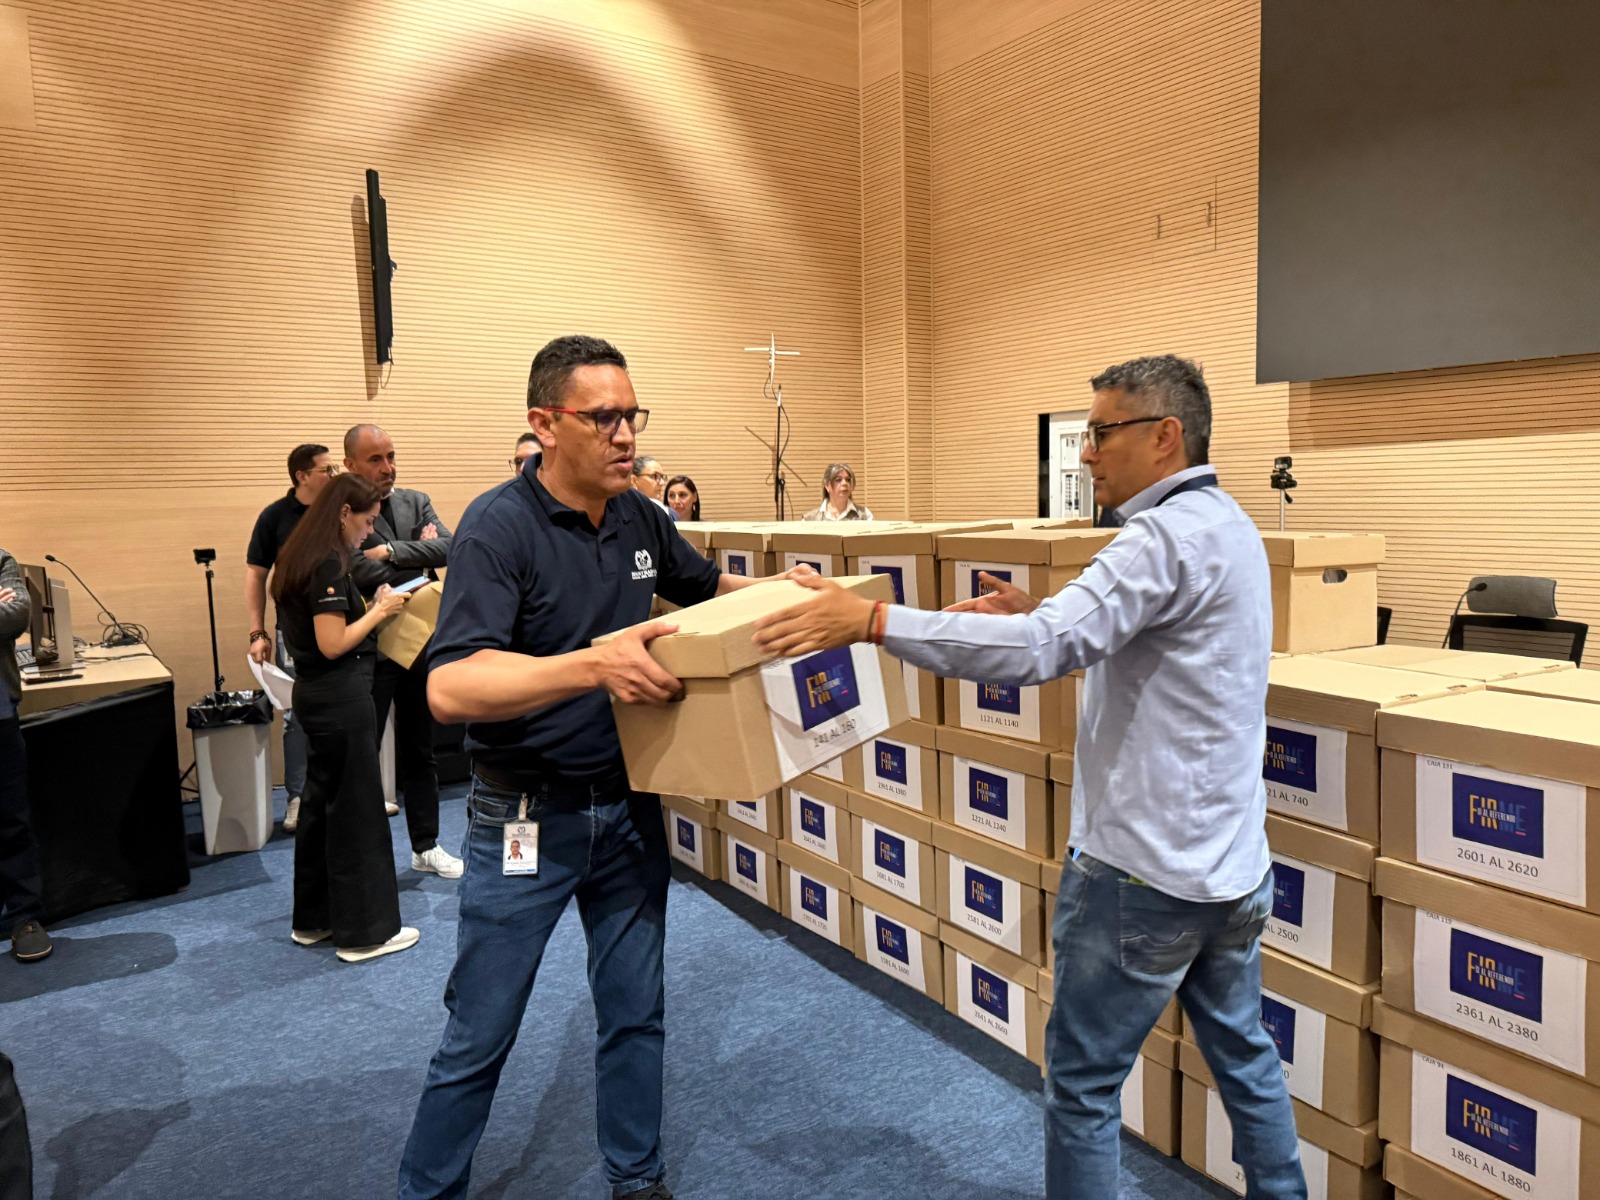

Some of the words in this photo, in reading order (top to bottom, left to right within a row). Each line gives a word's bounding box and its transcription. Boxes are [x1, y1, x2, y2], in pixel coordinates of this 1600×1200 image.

[979, 714, 994, 724] 1121
[994, 716, 1003, 725] AL
[1003, 718, 1019, 728] 1140
[1426, 759, 1441, 768] CAJA
[889, 785, 896, 794] AL
[1266, 787, 1278, 799] 21
[1279, 791, 1291, 802] AL
[1292, 795, 1308, 807] 740
[1469, 794, 1527, 832] FIRME
[1483, 808, 1489, 818] AL
[1489, 809, 1516, 823] REFERENDO
[971, 813, 986, 826] 1221
[985, 818, 993, 829] AL
[993, 821, 1007, 833] 1240
[1457, 847, 1485, 864] 2601
[1489, 856, 1504, 869] AL
[1507, 860, 1539, 878] 2620
[888, 876, 895, 886] AL
[893, 878, 906, 890] 1700
[967, 912, 980, 926] 2581
[980, 919, 988, 931] AL
[988, 923, 1002, 937] 2600
[1426, 911, 1441, 922] CAJA
[1264, 923, 1275, 935] AL
[1277, 927, 1299, 943] 2500
[892, 960, 899, 970] AL
[1467, 951, 1525, 996] FIRME
[1481, 966, 1487, 976] AL
[1487, 968, 1514, 986] REFERENDO
[987, 1016, 995, 1028] AL
[1456, 1002, 1485, 1022] 2361
[1488, 1015, 1503, 1030] AL
[1507, 1021, 1538, 1042] 2380
[1422, 1055, 1436, 1065] CAJA
[1476, 1114, 1482, 1123] AL
[1451, 1147, 1478, 1169] 1861
[1482, 1162, 1498, 1178] AL
[1500, 1170, 1531, 1193] 1880
